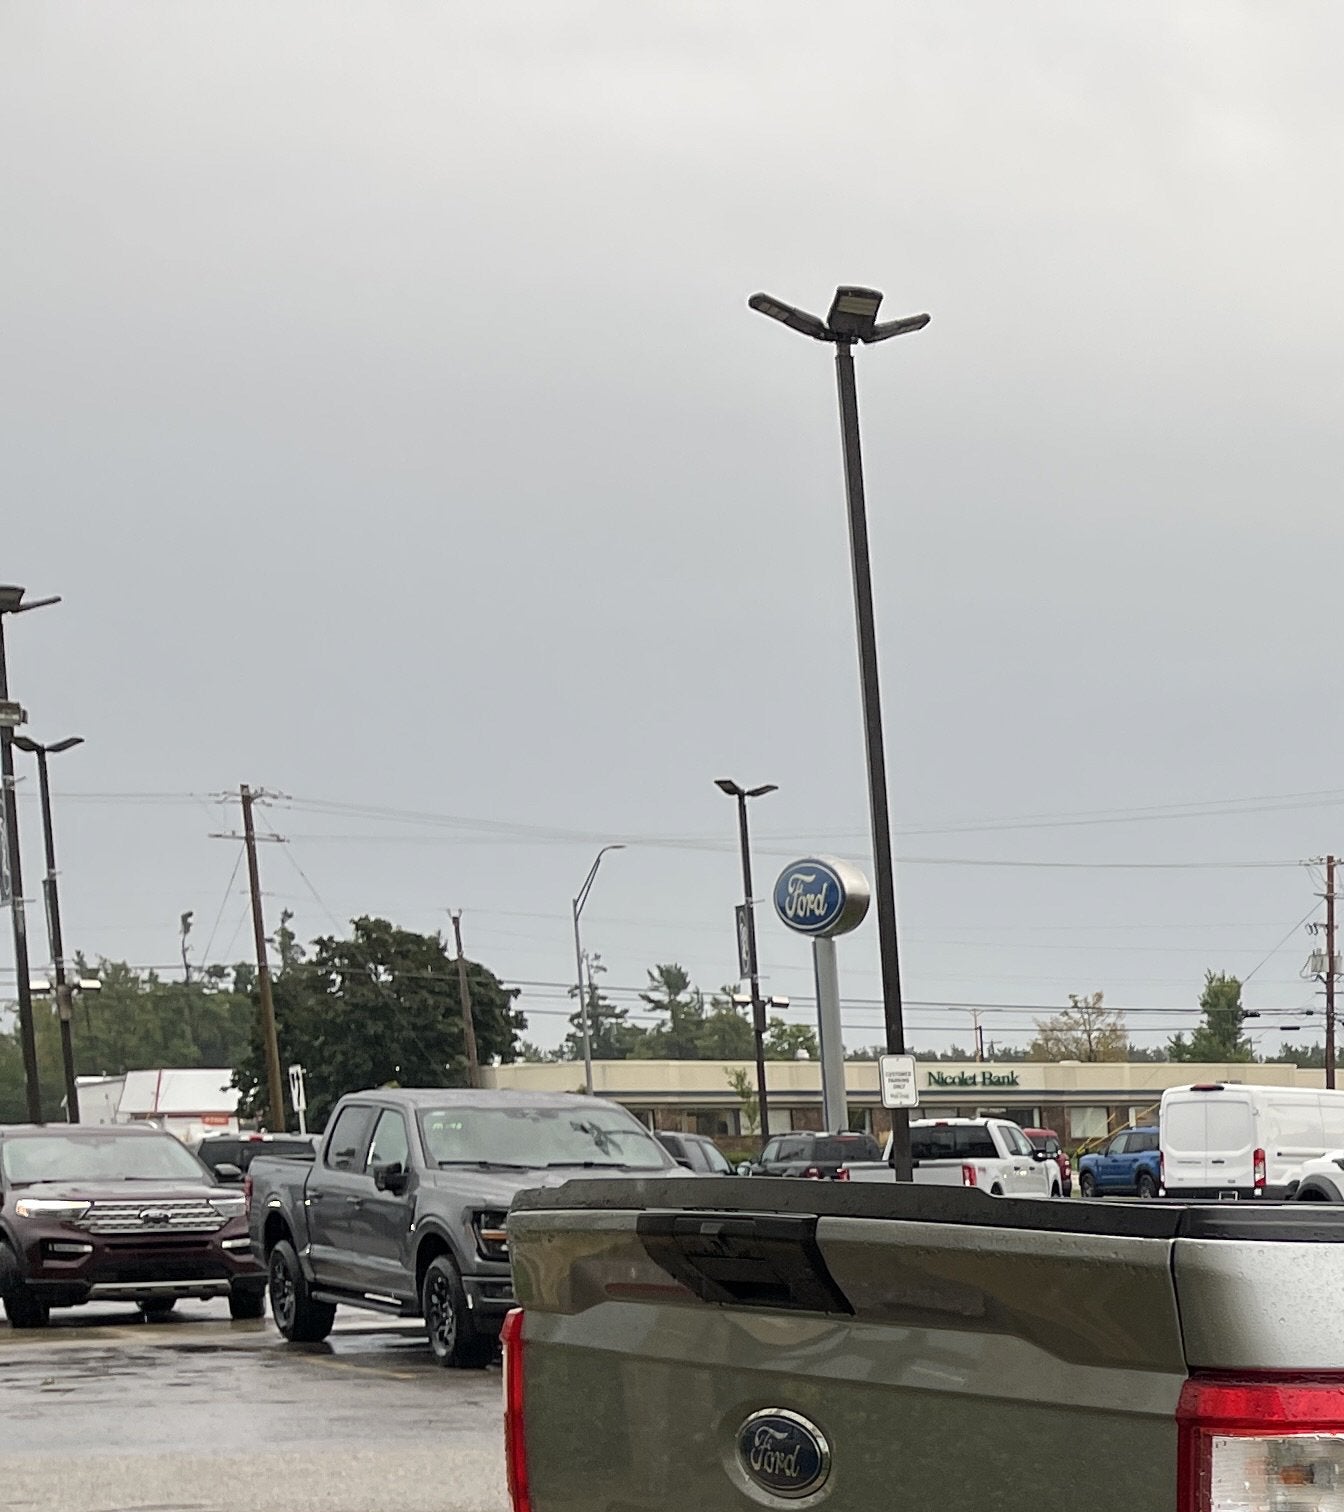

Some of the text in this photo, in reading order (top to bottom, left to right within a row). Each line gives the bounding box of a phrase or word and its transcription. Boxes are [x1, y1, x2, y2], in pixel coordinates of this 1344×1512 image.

[785, 873, 828, 918] Ford
[927, 1069, 1020, 1087] Nicolet Bank
[750, 1426, 801, 1478] Ford
